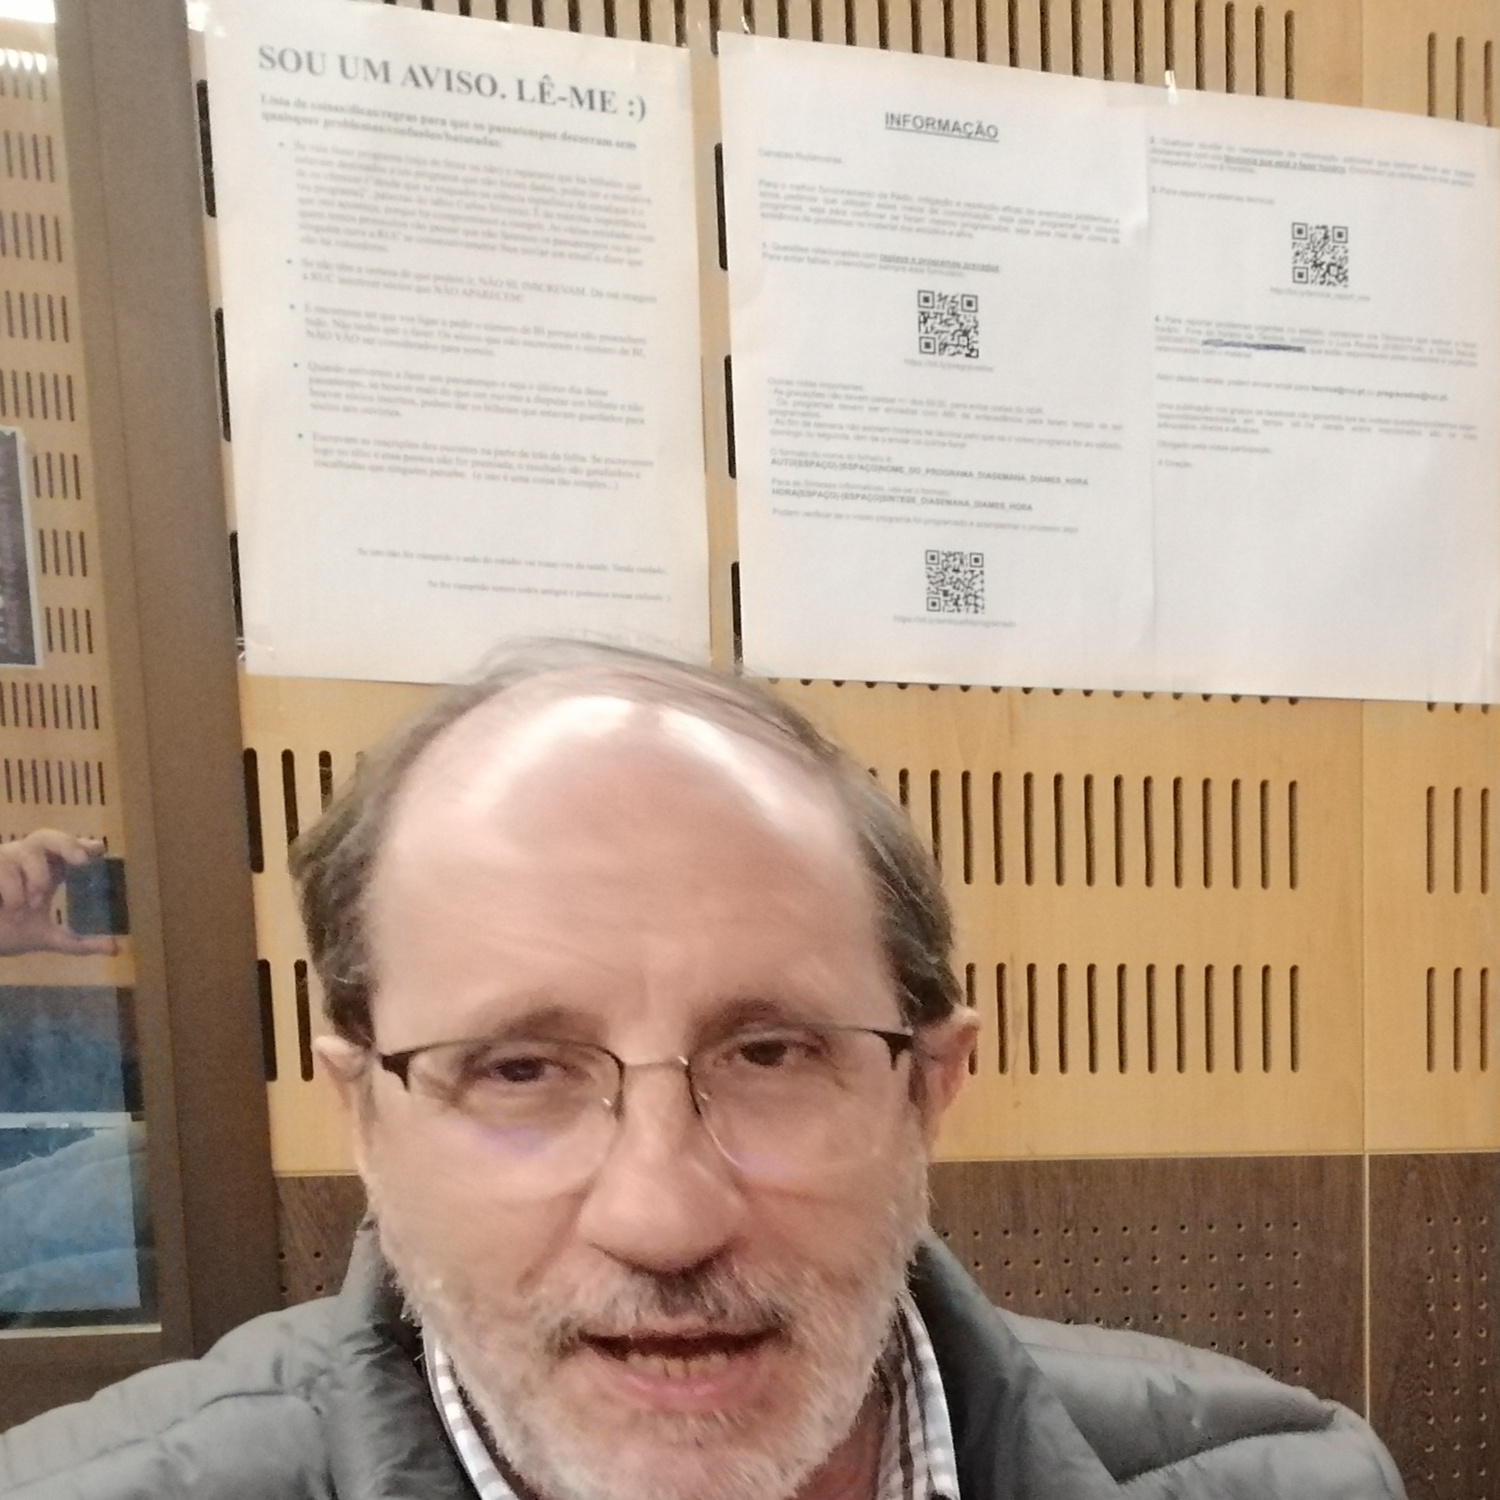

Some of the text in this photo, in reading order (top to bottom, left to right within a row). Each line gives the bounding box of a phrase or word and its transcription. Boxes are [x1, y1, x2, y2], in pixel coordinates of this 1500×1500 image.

[258, 45, 327, 77] SOU
[338, 54, 392, 84] UM
[400, 64, 507, 100] AVISO.
[516, 74, 618, 115] LÊ-ME
[885, 112, 1000, 141] INFORMAÇÃO
